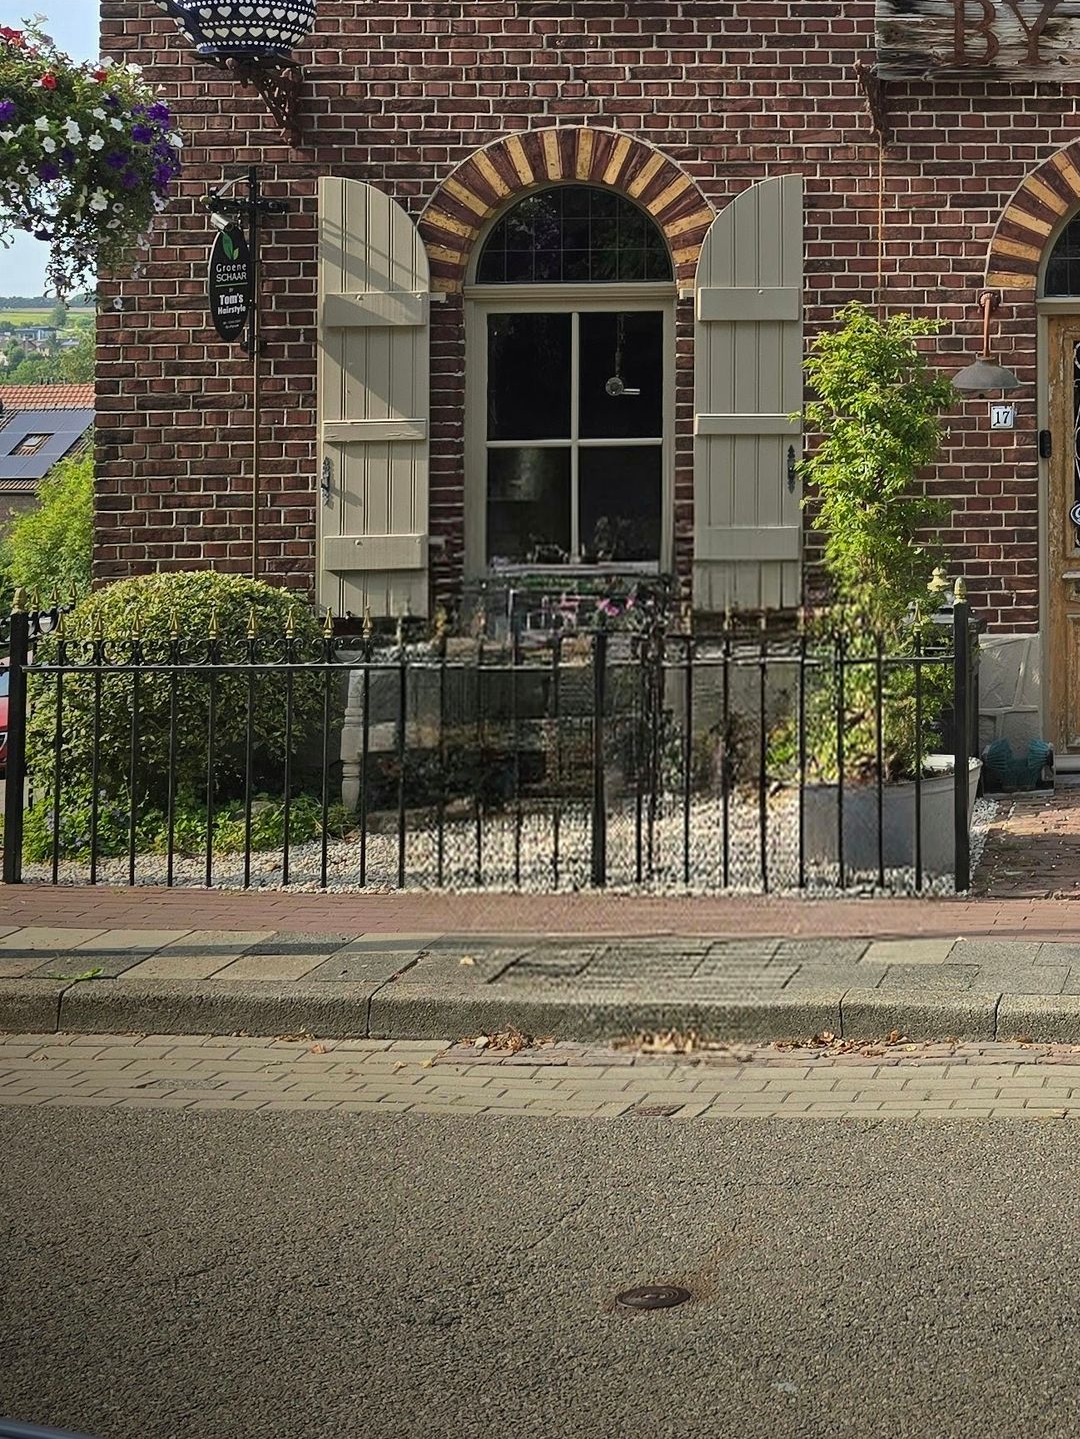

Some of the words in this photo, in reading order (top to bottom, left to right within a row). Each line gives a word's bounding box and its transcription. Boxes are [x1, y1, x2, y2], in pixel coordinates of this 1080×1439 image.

[216, 263, 247, 272] Groene
[216, 272, 247, 282] SCHAAR
[219, 293, 243, 305] Tom's
[217, 304, 246, 315] Hairstyle
[996, 411, 1010, 424] 17
